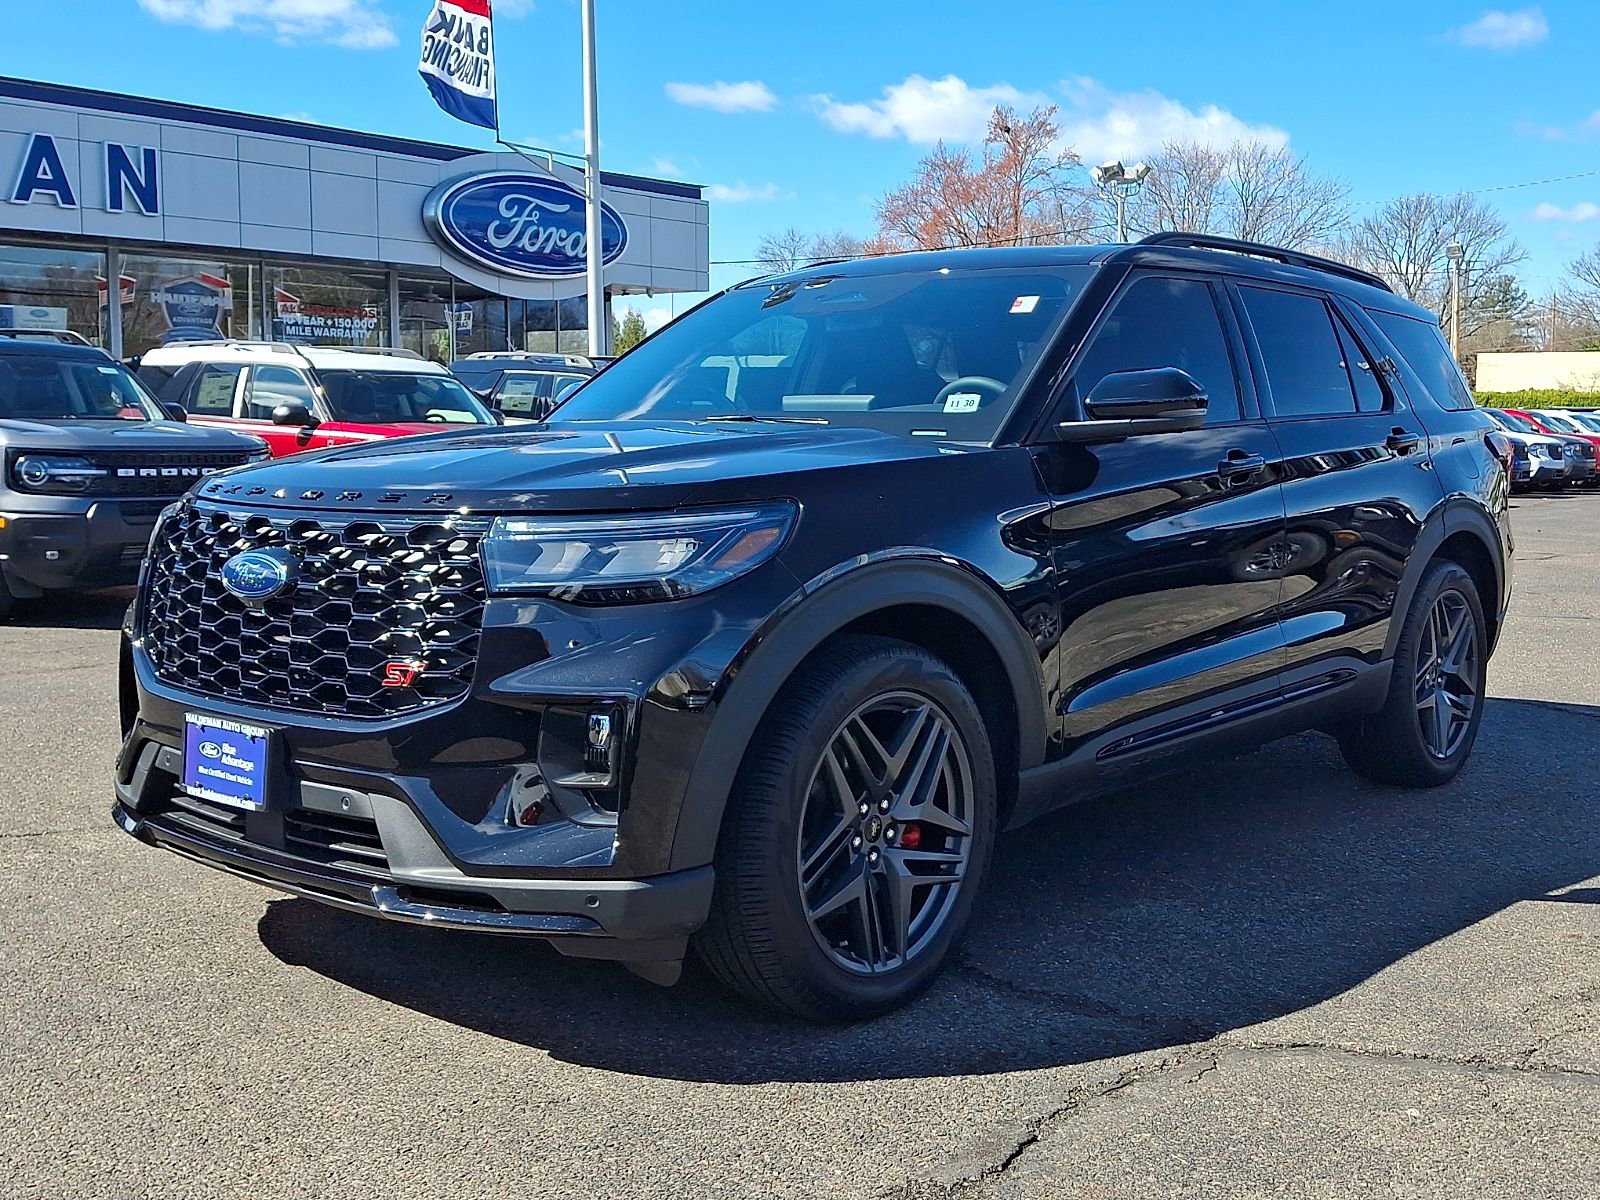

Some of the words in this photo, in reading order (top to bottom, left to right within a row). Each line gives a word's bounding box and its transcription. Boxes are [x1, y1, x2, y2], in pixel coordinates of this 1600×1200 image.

[286, 326, 312, 336] MILE
[313, 327, 371, 339] WARRANTY
[117, 467, 216, 477] BRONC
[381, 662, 426, 687] ST
